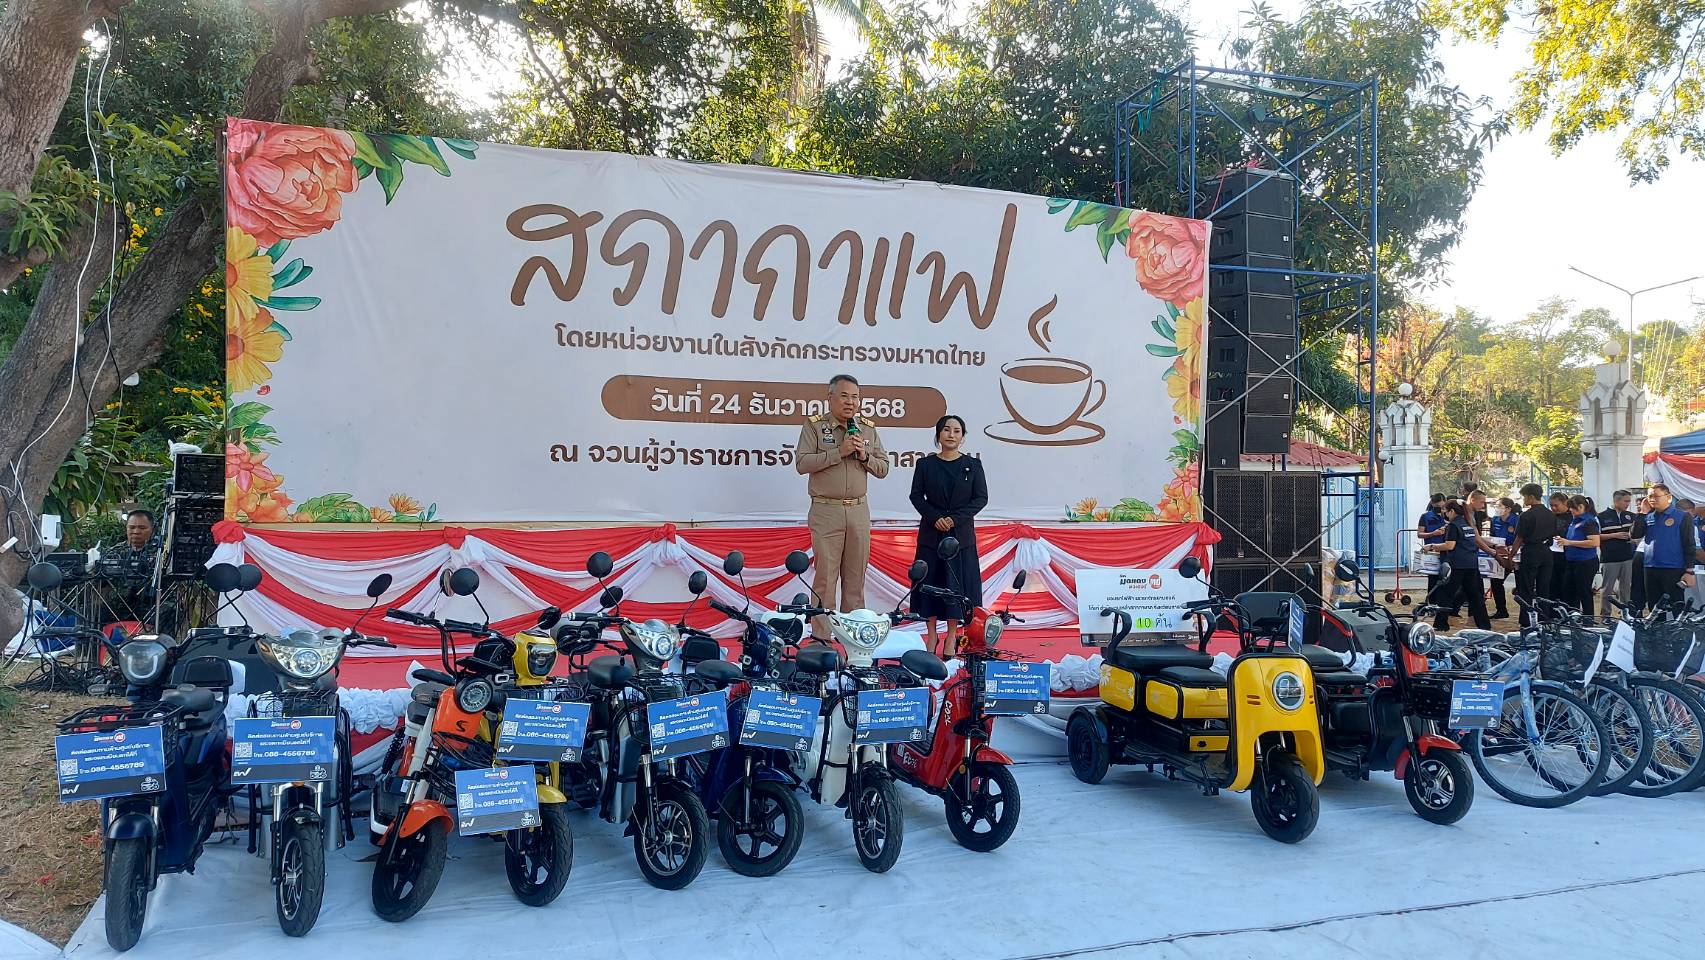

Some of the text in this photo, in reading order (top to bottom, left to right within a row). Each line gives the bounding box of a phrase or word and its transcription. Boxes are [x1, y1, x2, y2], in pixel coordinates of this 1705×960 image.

[506, 203, 1018, 329] สภากาแฟ
[554, 323, 986, 367] โดยหน่วยงานในสังกัดกระทรวงมหาดไทย
[651, 383, 906, 418] วันที่ 24 ธันวาค 568
[550, 444, 578, 463] ณ
[1137, 617, 1152, 628] 10
